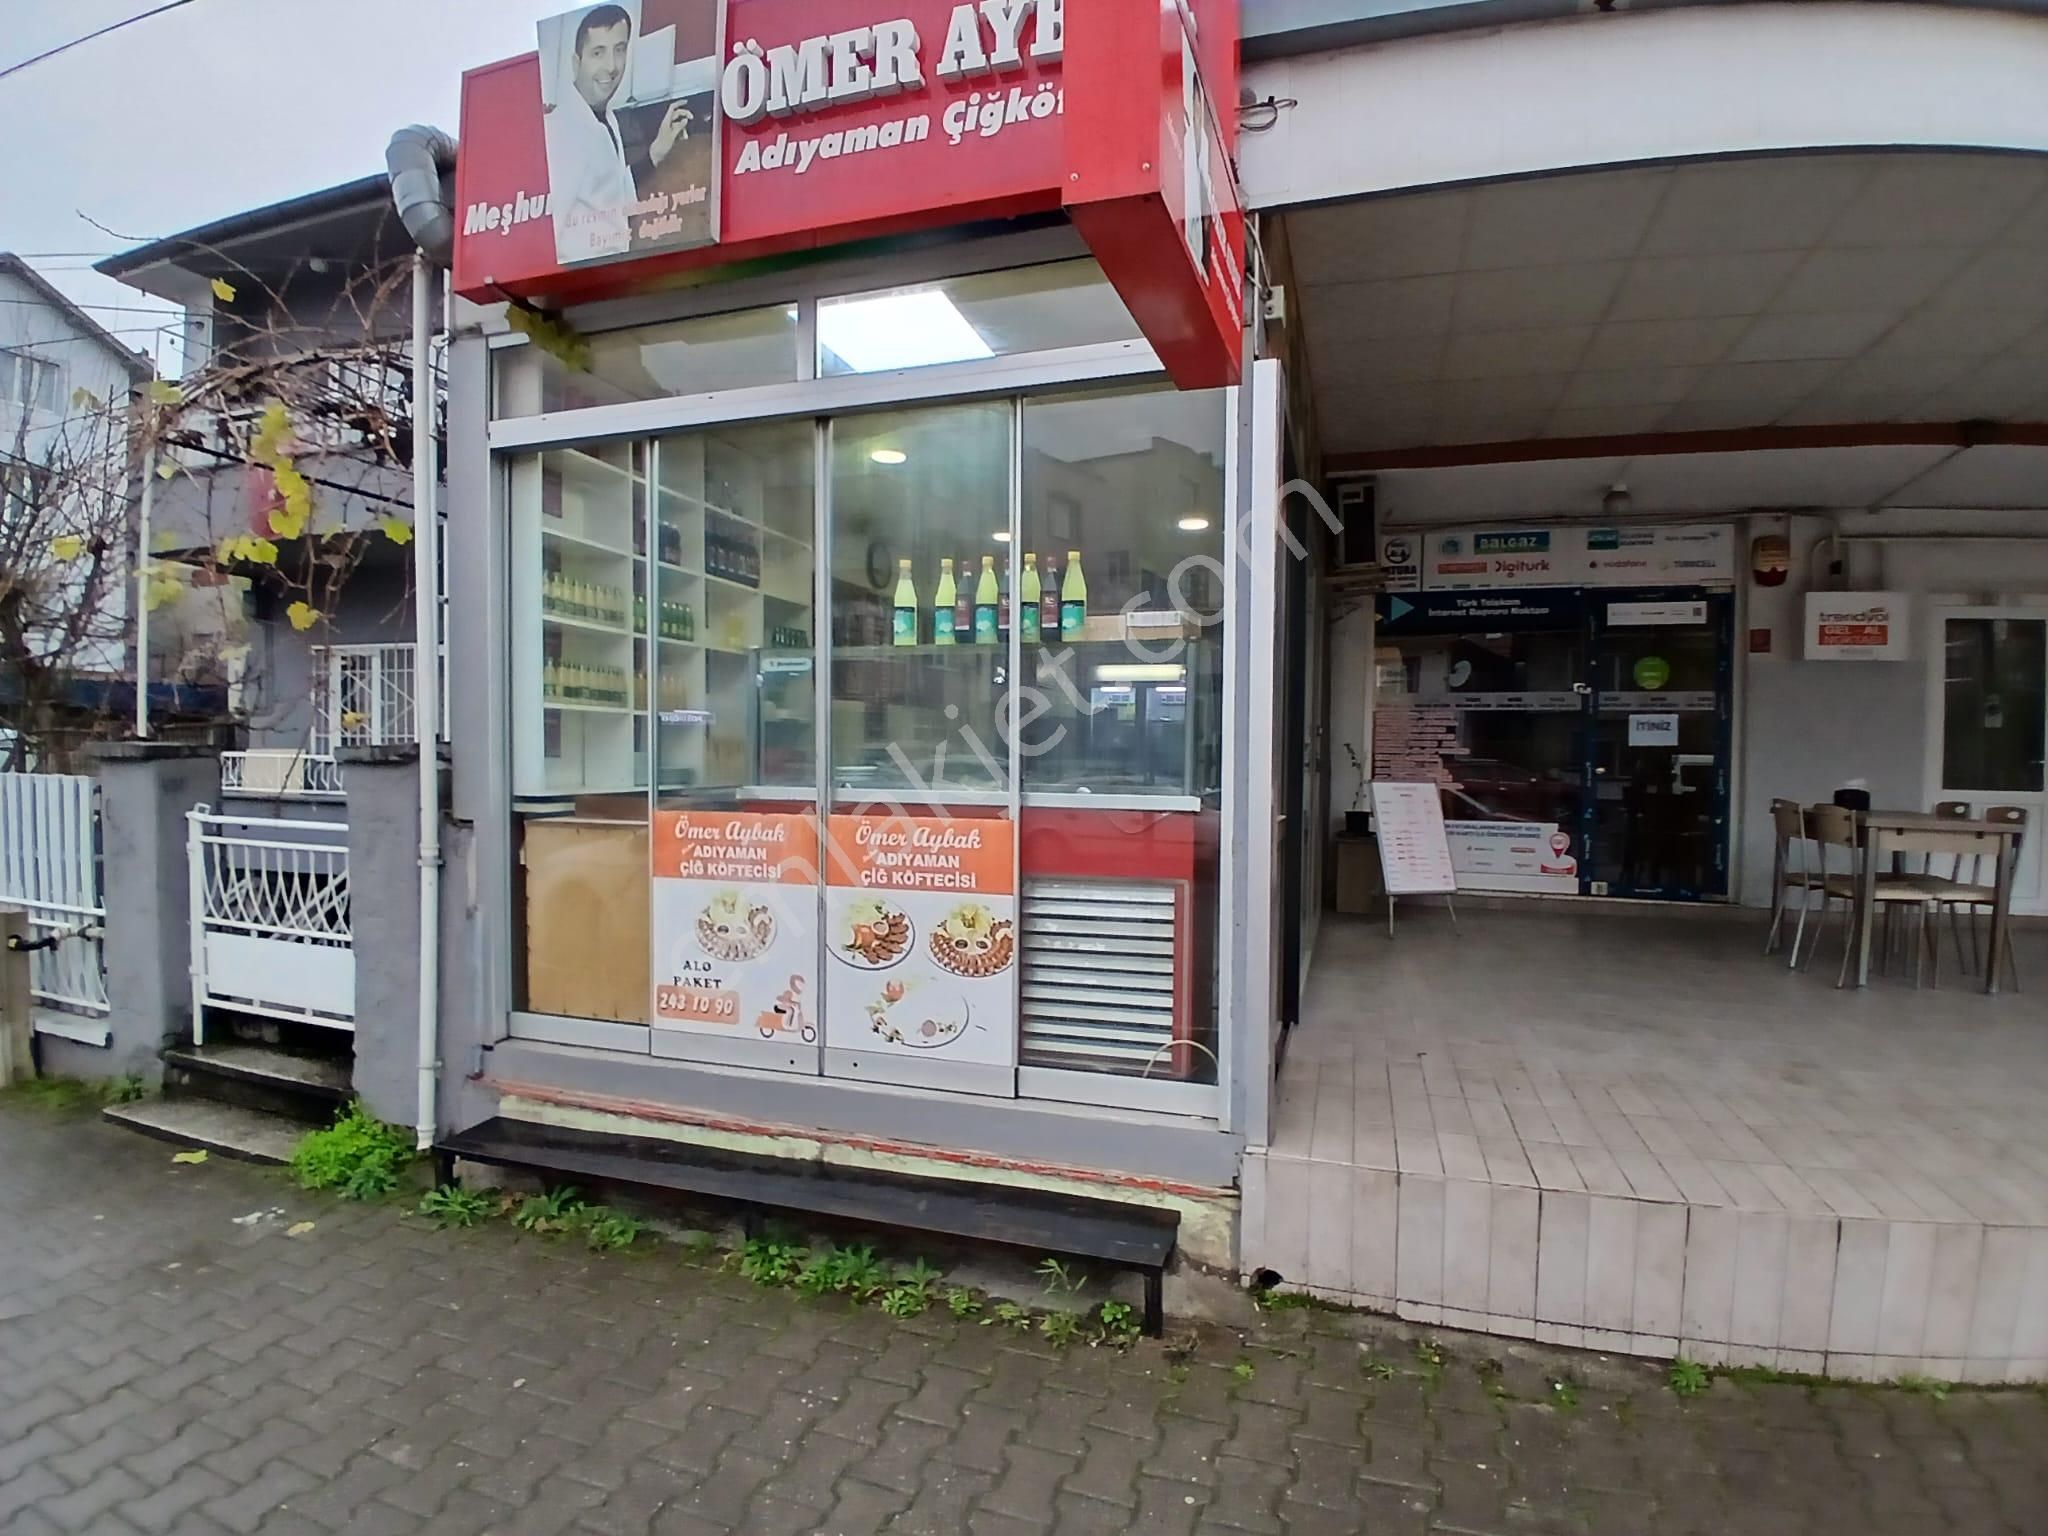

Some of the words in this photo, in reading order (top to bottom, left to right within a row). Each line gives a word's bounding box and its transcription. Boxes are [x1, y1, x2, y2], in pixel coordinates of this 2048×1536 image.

[721, 18, 926, 124] ÖMER
[733, 114, 931, 175] Adıyaman
[674, 815, 721, 839] Ömer
[725, 820, 785, 846] Aybak
[855, 819, 908, 847] Ömer
[911, 826, 982, 851] Aybak
[692, 845, 767, 860] ADIYAMAN
[876, 852, 960, 868] ADIYAMAN
[680, 860, 704, 877] ÇİĞ
[707, 862, 782, 879] KÖFTECİSİ
[861, 869, 888, 887] ÇİĞ
[892, 869, 977, 889] KÖFTECİSİ
[683, 960, 712, 972] ALO
[673, 976, 722, 990] PAKET
[715, 998, 734, 1016] 90
